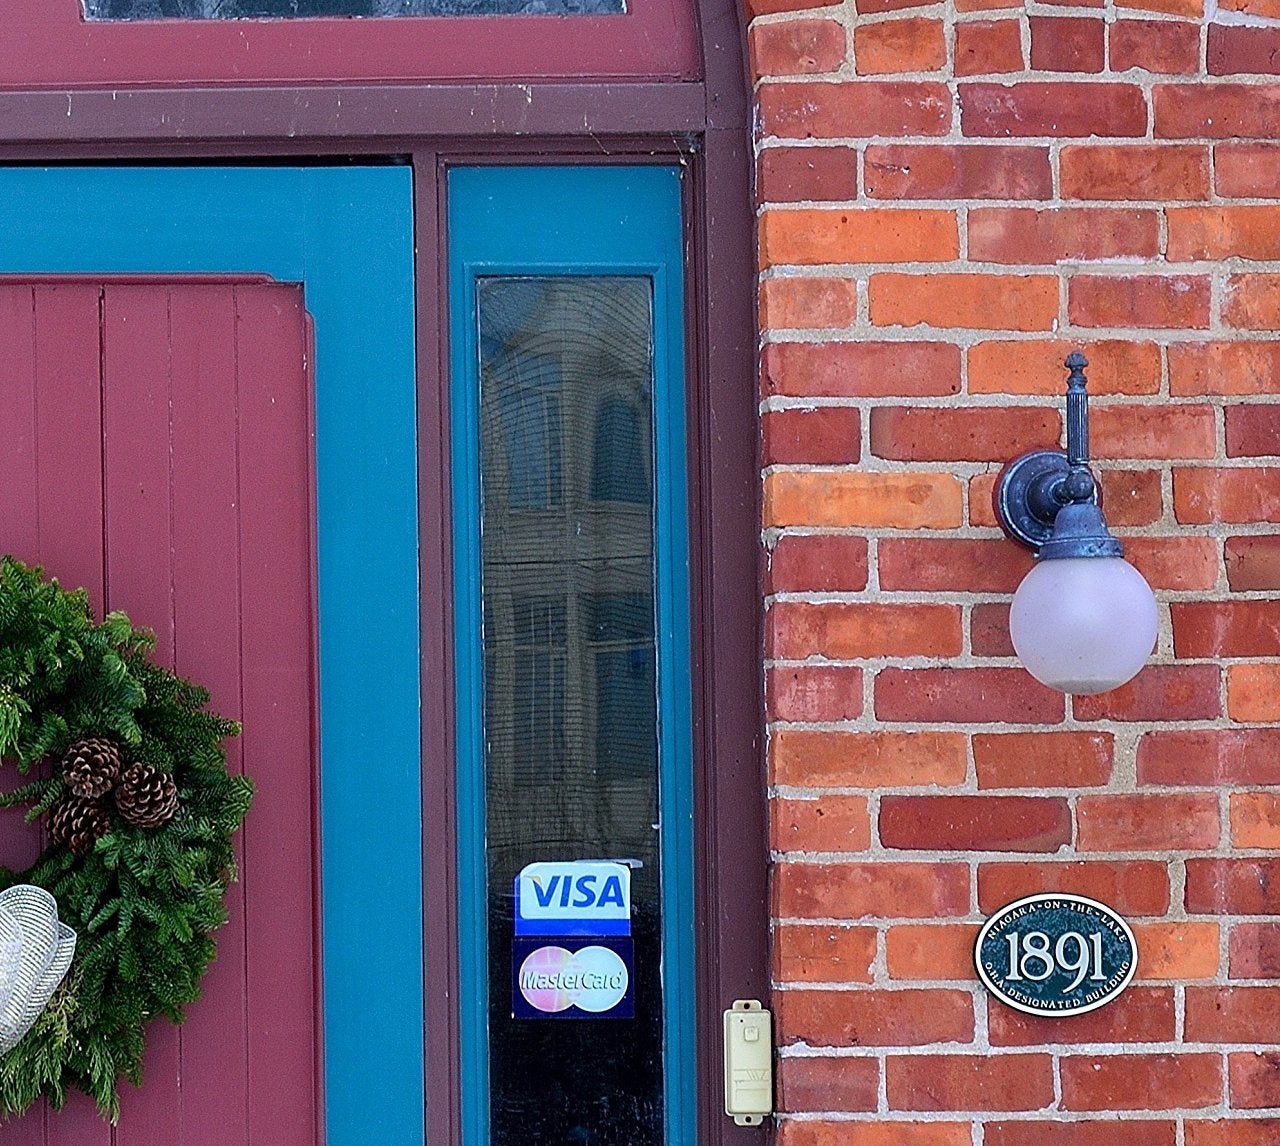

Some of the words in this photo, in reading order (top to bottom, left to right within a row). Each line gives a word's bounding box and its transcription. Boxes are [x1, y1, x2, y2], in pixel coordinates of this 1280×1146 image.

[527, 875, 625, 908] VISA
[988, 901, 1128, 943] NIAGARA-ON-THE-LAKE
[521, 970, 622, 990] MasterCard
[1005, 931, 1108, 994] 1891
[1007, 988, 1081, 1009] DESIGNATED
[1085, 961, 1130, 1002] BUILDING
